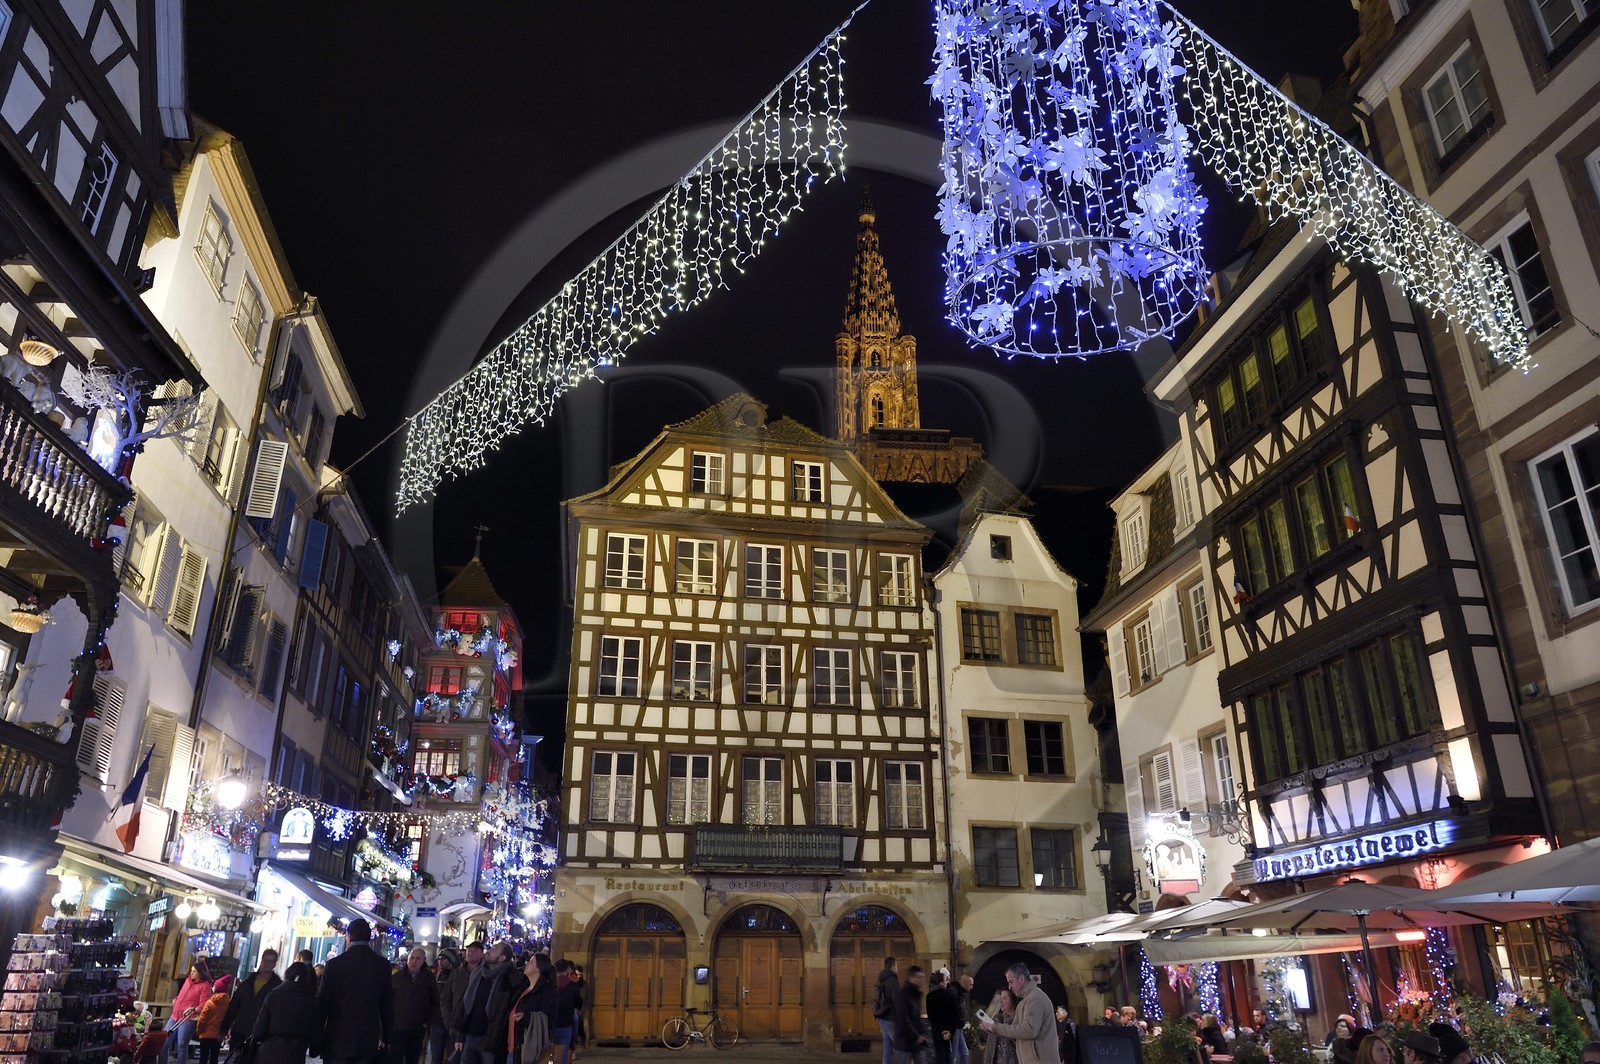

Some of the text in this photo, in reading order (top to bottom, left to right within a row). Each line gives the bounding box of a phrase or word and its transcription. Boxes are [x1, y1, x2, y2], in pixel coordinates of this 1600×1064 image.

[1254, 821, 1441, 880] Muensterstuewel
[604, 877, 685, 892] Restaurant
[836, 880, 913, 895] Adelshoffen
